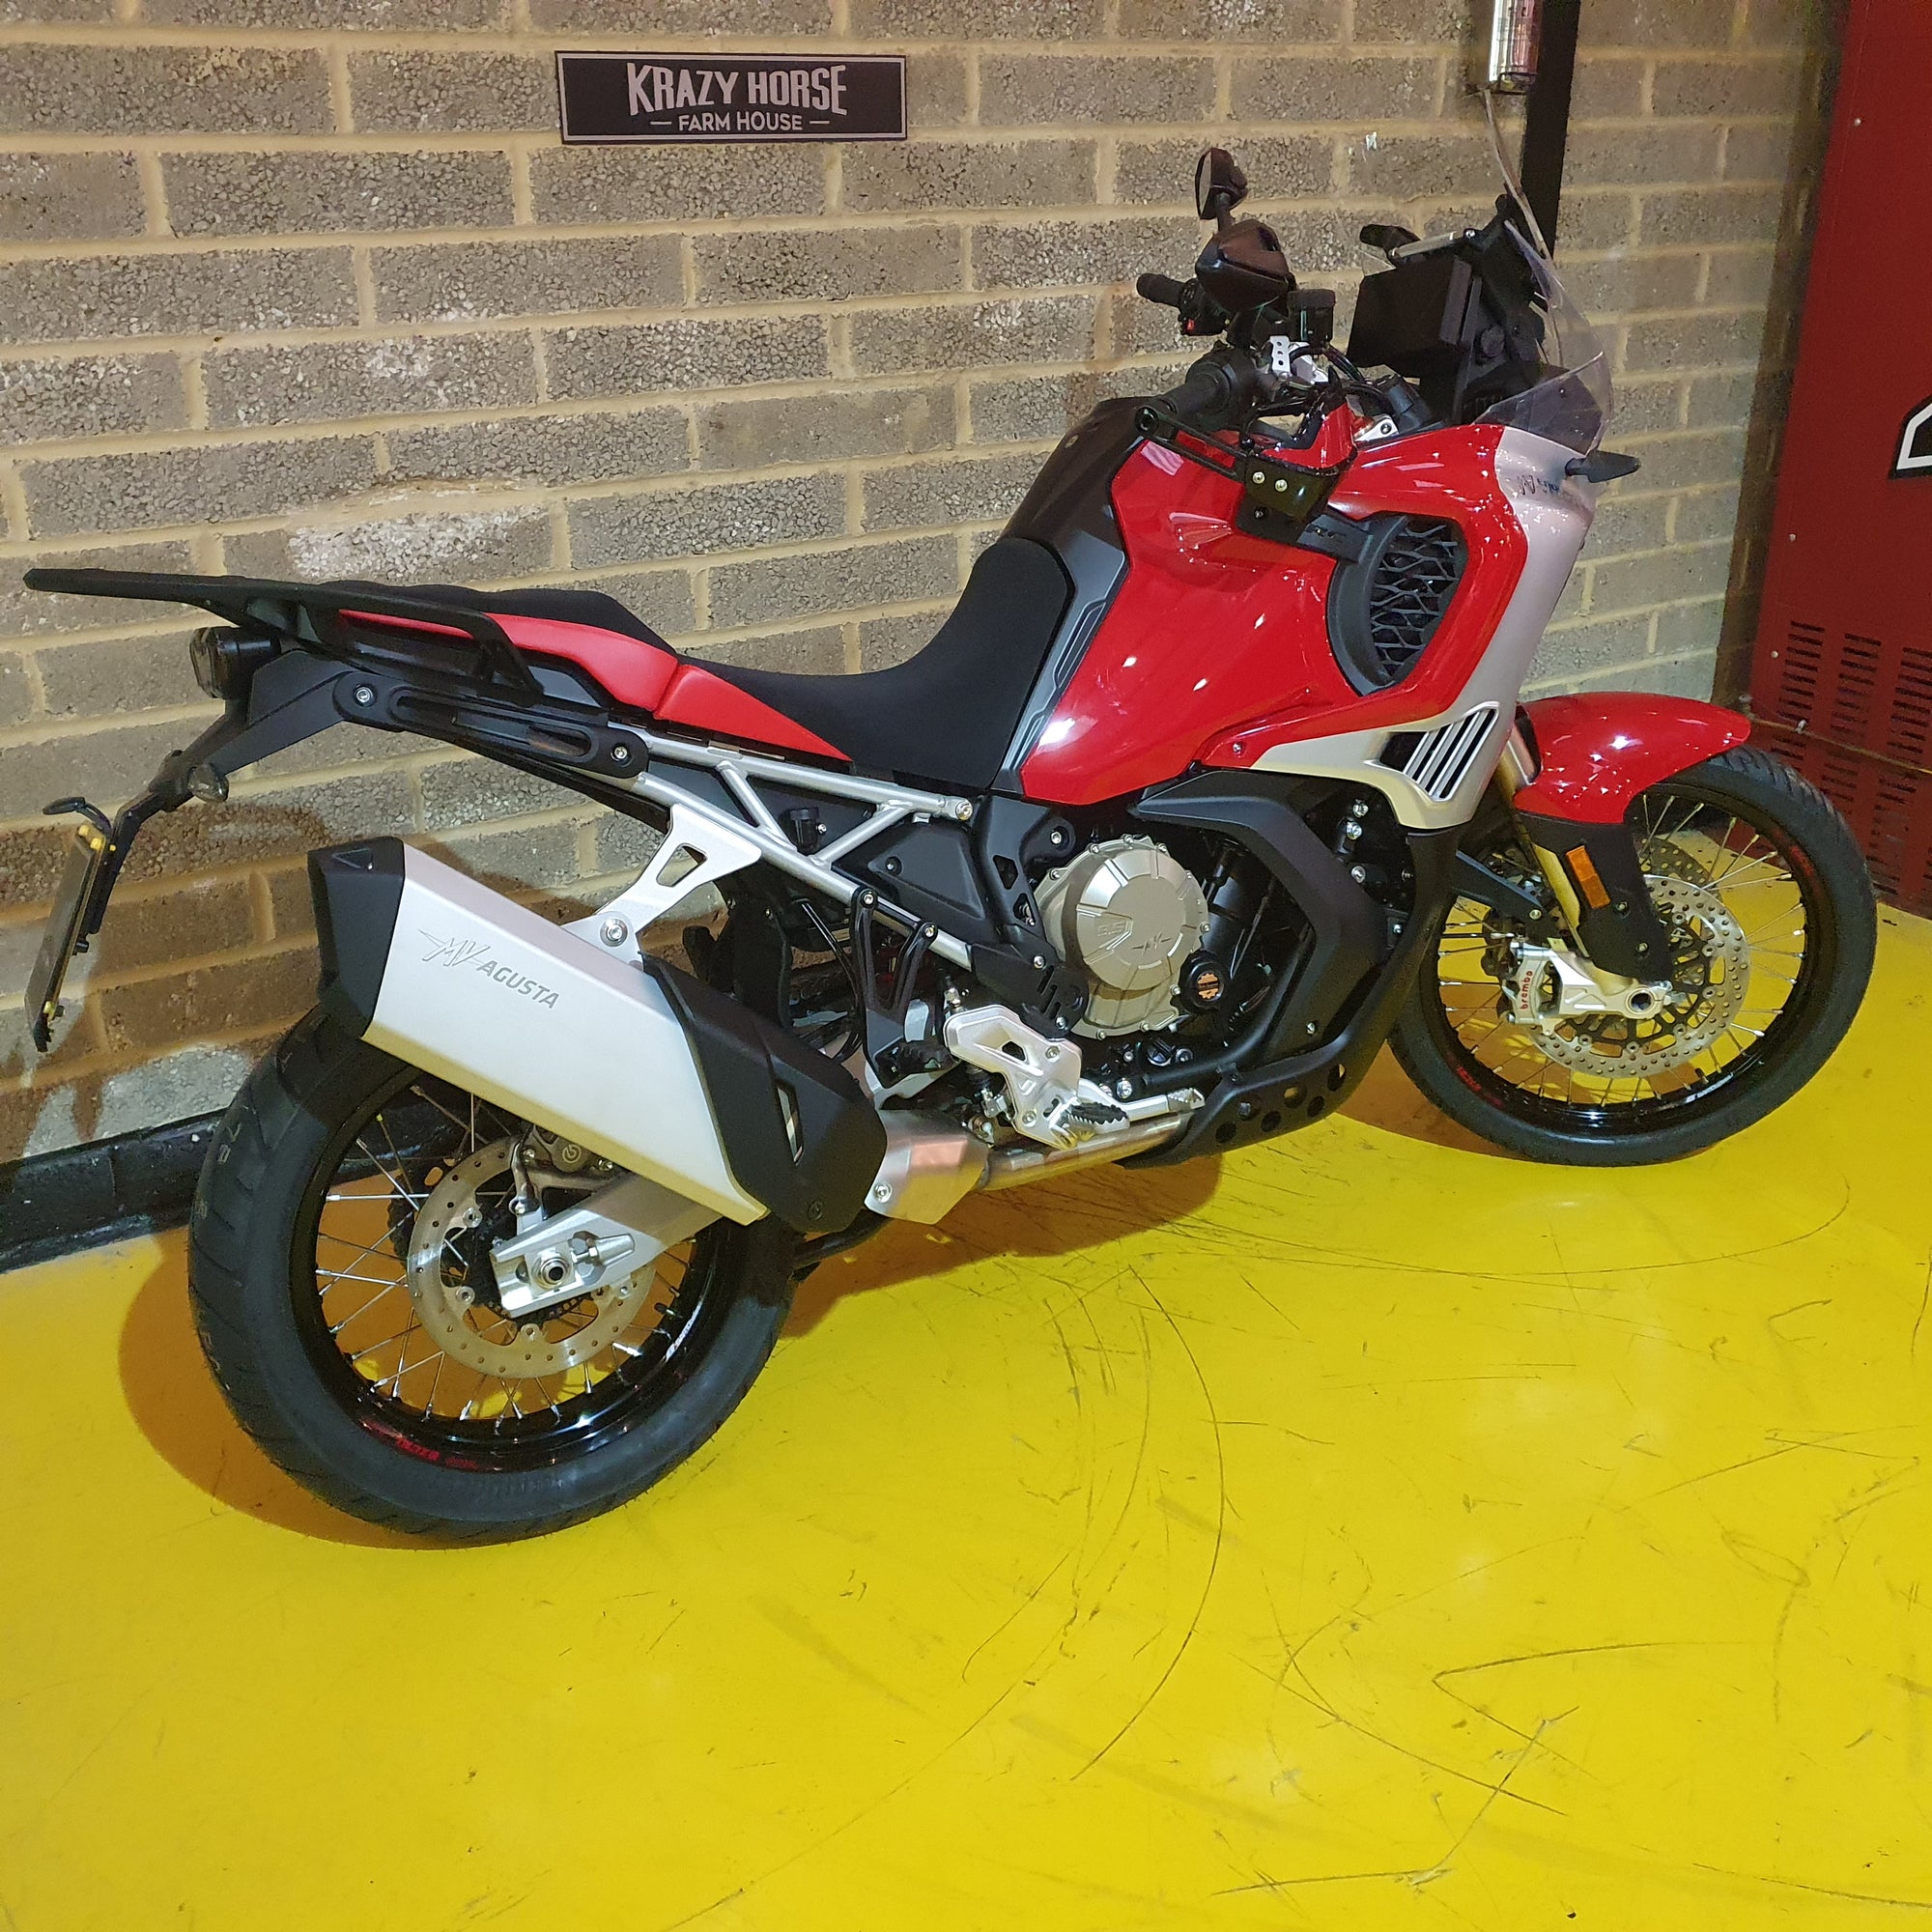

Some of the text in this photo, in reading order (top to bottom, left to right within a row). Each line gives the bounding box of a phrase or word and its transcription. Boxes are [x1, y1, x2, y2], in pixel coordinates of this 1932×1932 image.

[626, 62, 848, 117] KRAZY HORSE
[678, 111, 804, 131] FARM HOUSE
[475, 959, 560, 1009] AGUSTA
[1519, 970, 1534, 1010] brembo
